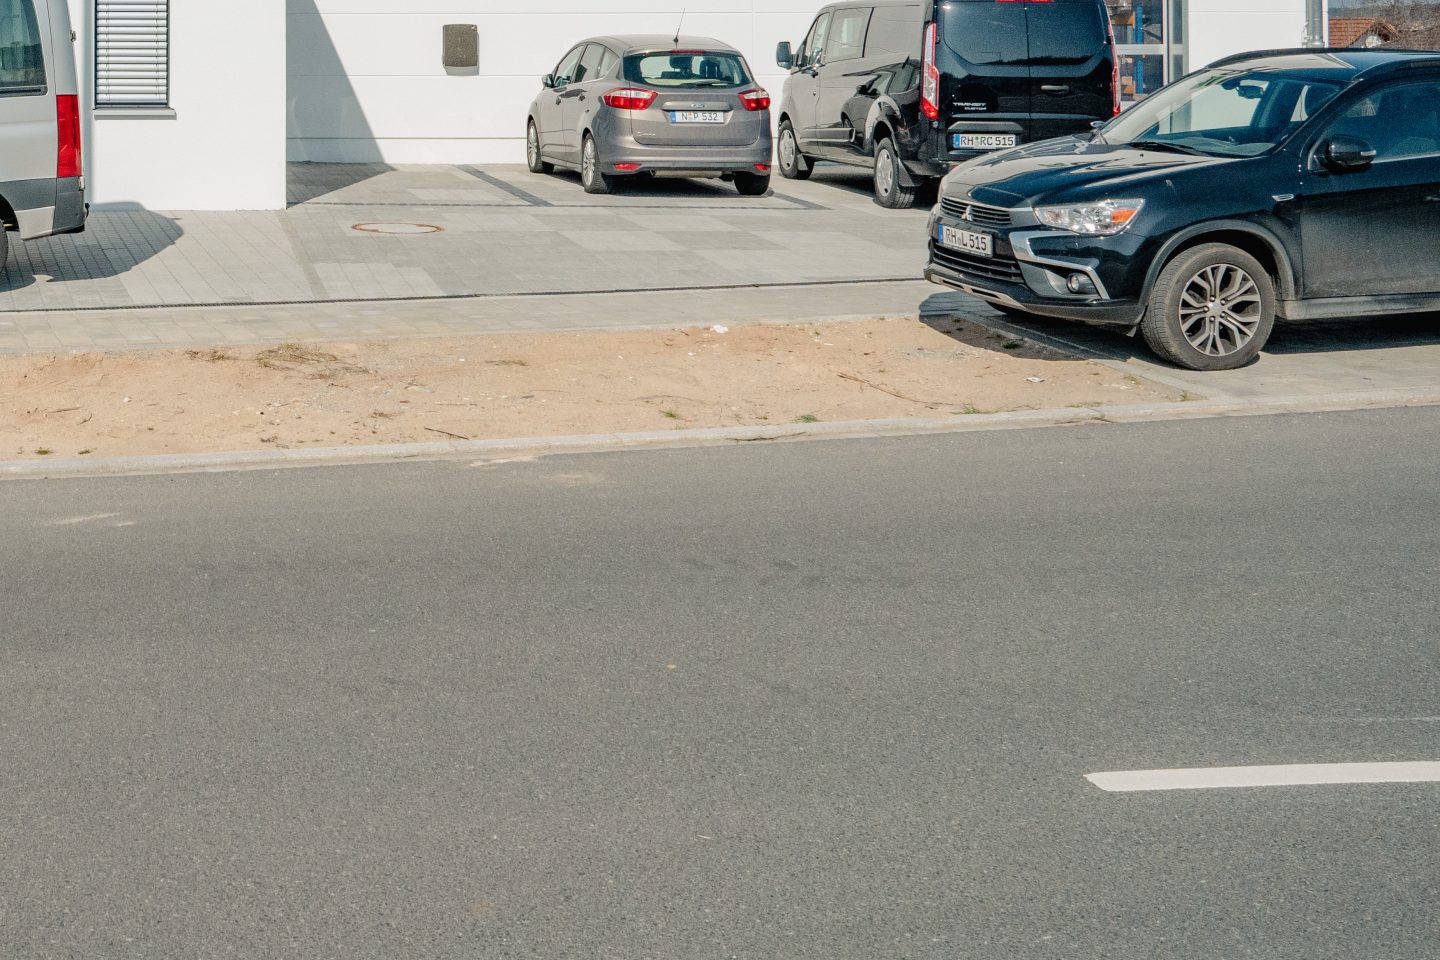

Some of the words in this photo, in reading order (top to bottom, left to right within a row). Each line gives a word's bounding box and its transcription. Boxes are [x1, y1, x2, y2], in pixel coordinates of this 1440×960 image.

[681, 112, 688, 121] N
[693, 112, 699, 121] P
[701, 112, 719, 121] 532
[960, 136, 974, 146] RH
[980, 136, 993, 146] RC
[995, 136, 1014, 146] 515
[945, 228, 957, 245] RH
[961, 232, 968, 247] L
[969, 234, 987, 251] 515
